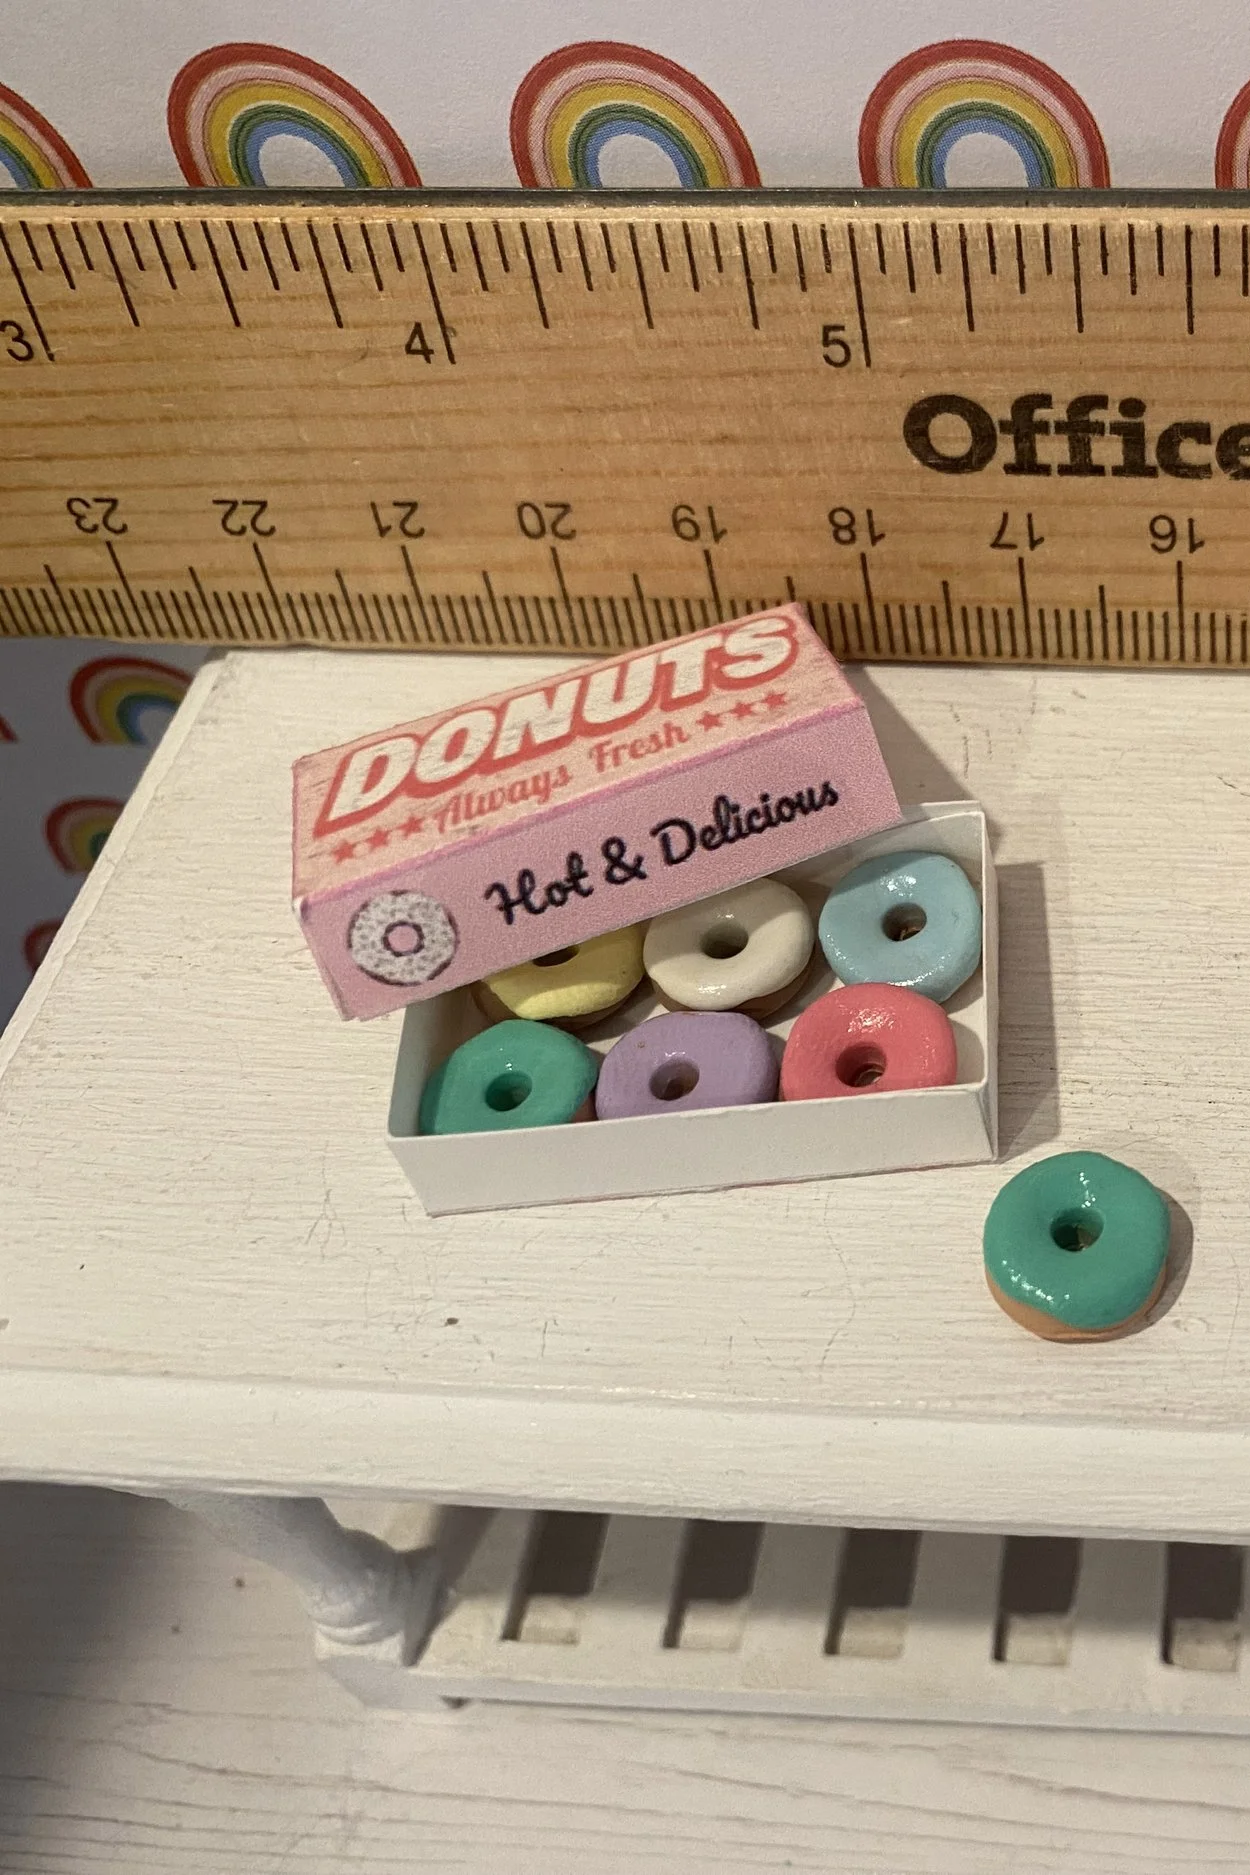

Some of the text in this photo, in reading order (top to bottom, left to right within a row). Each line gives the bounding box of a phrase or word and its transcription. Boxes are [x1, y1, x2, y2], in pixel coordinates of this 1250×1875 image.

[0, 320, 34, 361] 3
[404, 321, 436, 364] 4
[822, 324, 851, 368] 5
[65, 497, 128, 535] 23
[211, 498, 276, 537] 22
[369, 500, 426, 539] 21
[516, 502, 577, 541] 20
[672, 503, 730, 543] 19
[828, 507, 886, 547] 18
[990, 511, 1045, 552] 17
[1149, 514, 1205, 553] 16
[316, 615, 798, 836] DONUTS
[434, 722, 692, 833] Always Fresh
[484, 781, 839, 925] Hot & Delicious
